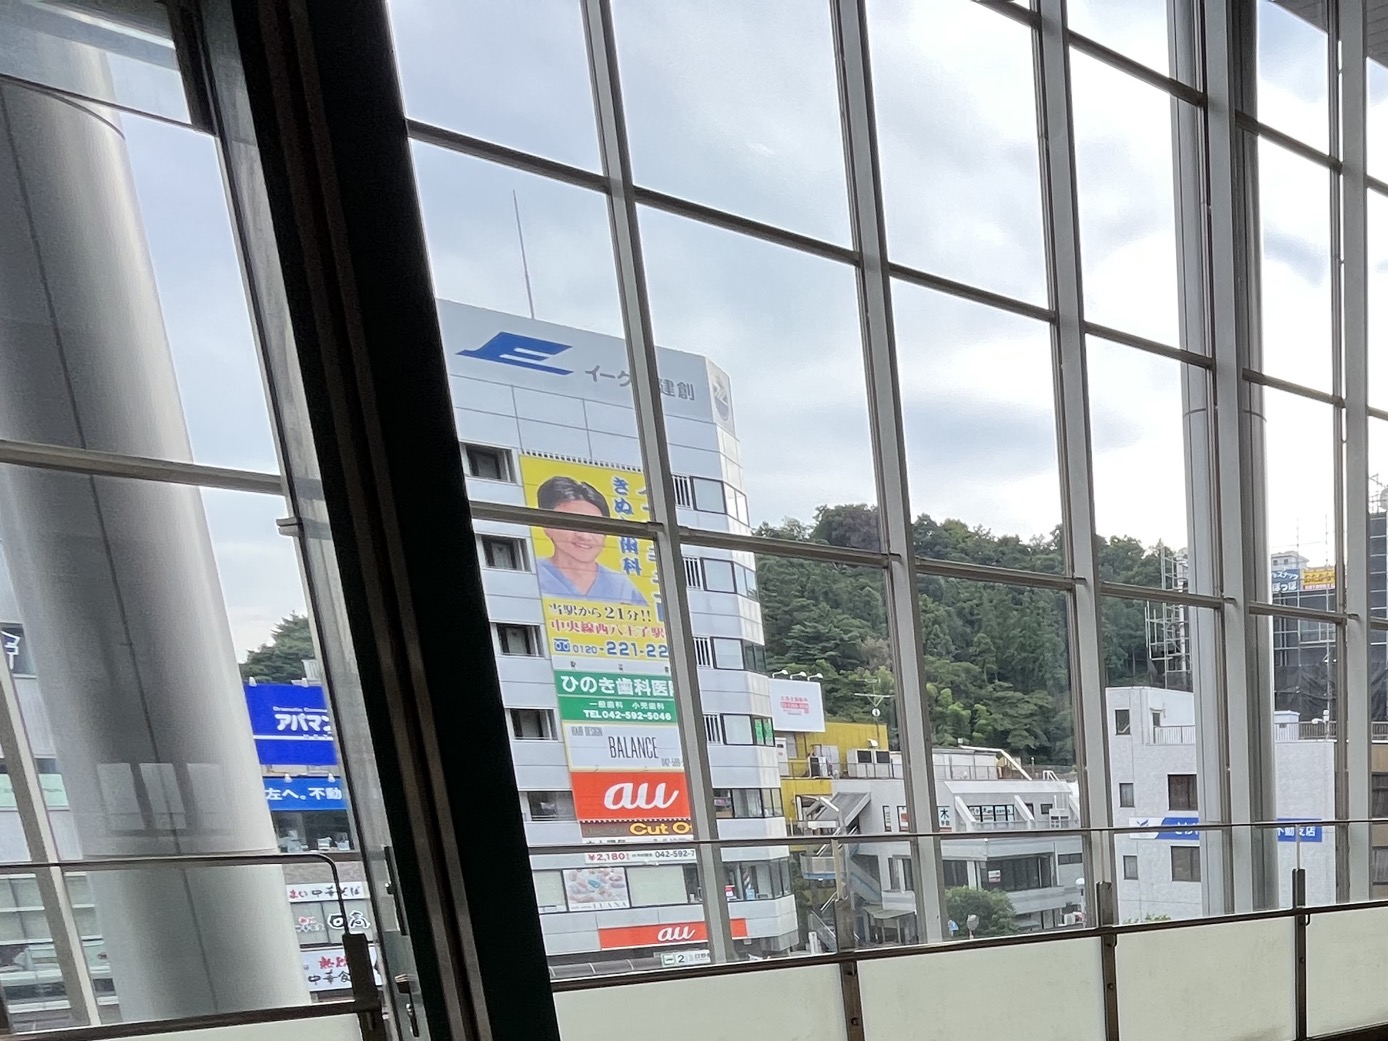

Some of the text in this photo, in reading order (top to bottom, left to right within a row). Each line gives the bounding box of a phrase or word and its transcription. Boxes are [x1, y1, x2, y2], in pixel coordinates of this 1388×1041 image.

[612, 476, 643, 577] きぬ歯科
[608, 736, 659, 759] BALANCE
[604, 782, 680, 810] au
[629, 822, 693, 836] Cut O
[658, 926, 696, 942] au
